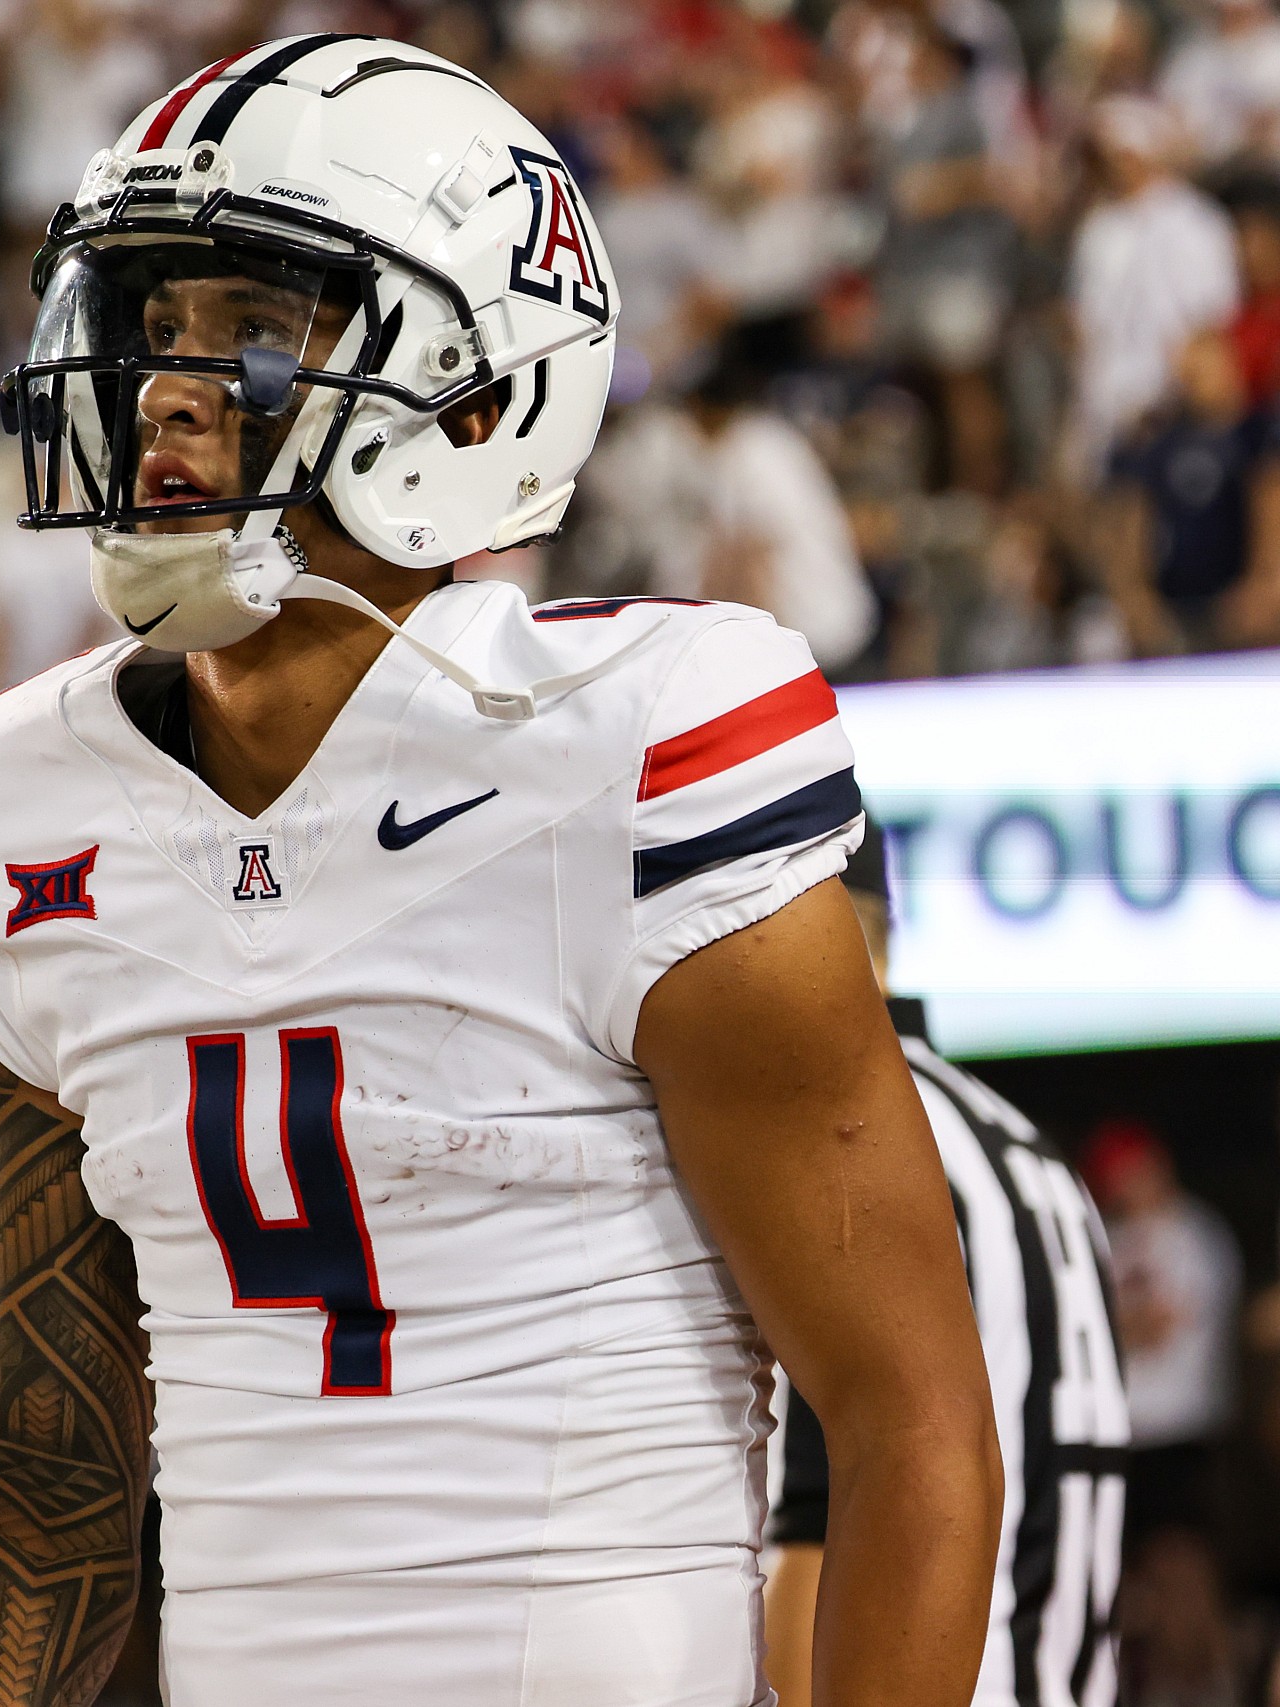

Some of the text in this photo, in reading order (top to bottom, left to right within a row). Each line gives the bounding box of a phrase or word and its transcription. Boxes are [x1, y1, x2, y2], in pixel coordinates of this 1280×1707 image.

[122, 164, 184, 184] ARIZON
[260, 185, 329, 207] BEARDOWN
[507, 144, 609, 326] A
[10, 855, 91, 927] XII
[232, 844, 282, 901] A
[186, 1025, 397, 1397] 4
